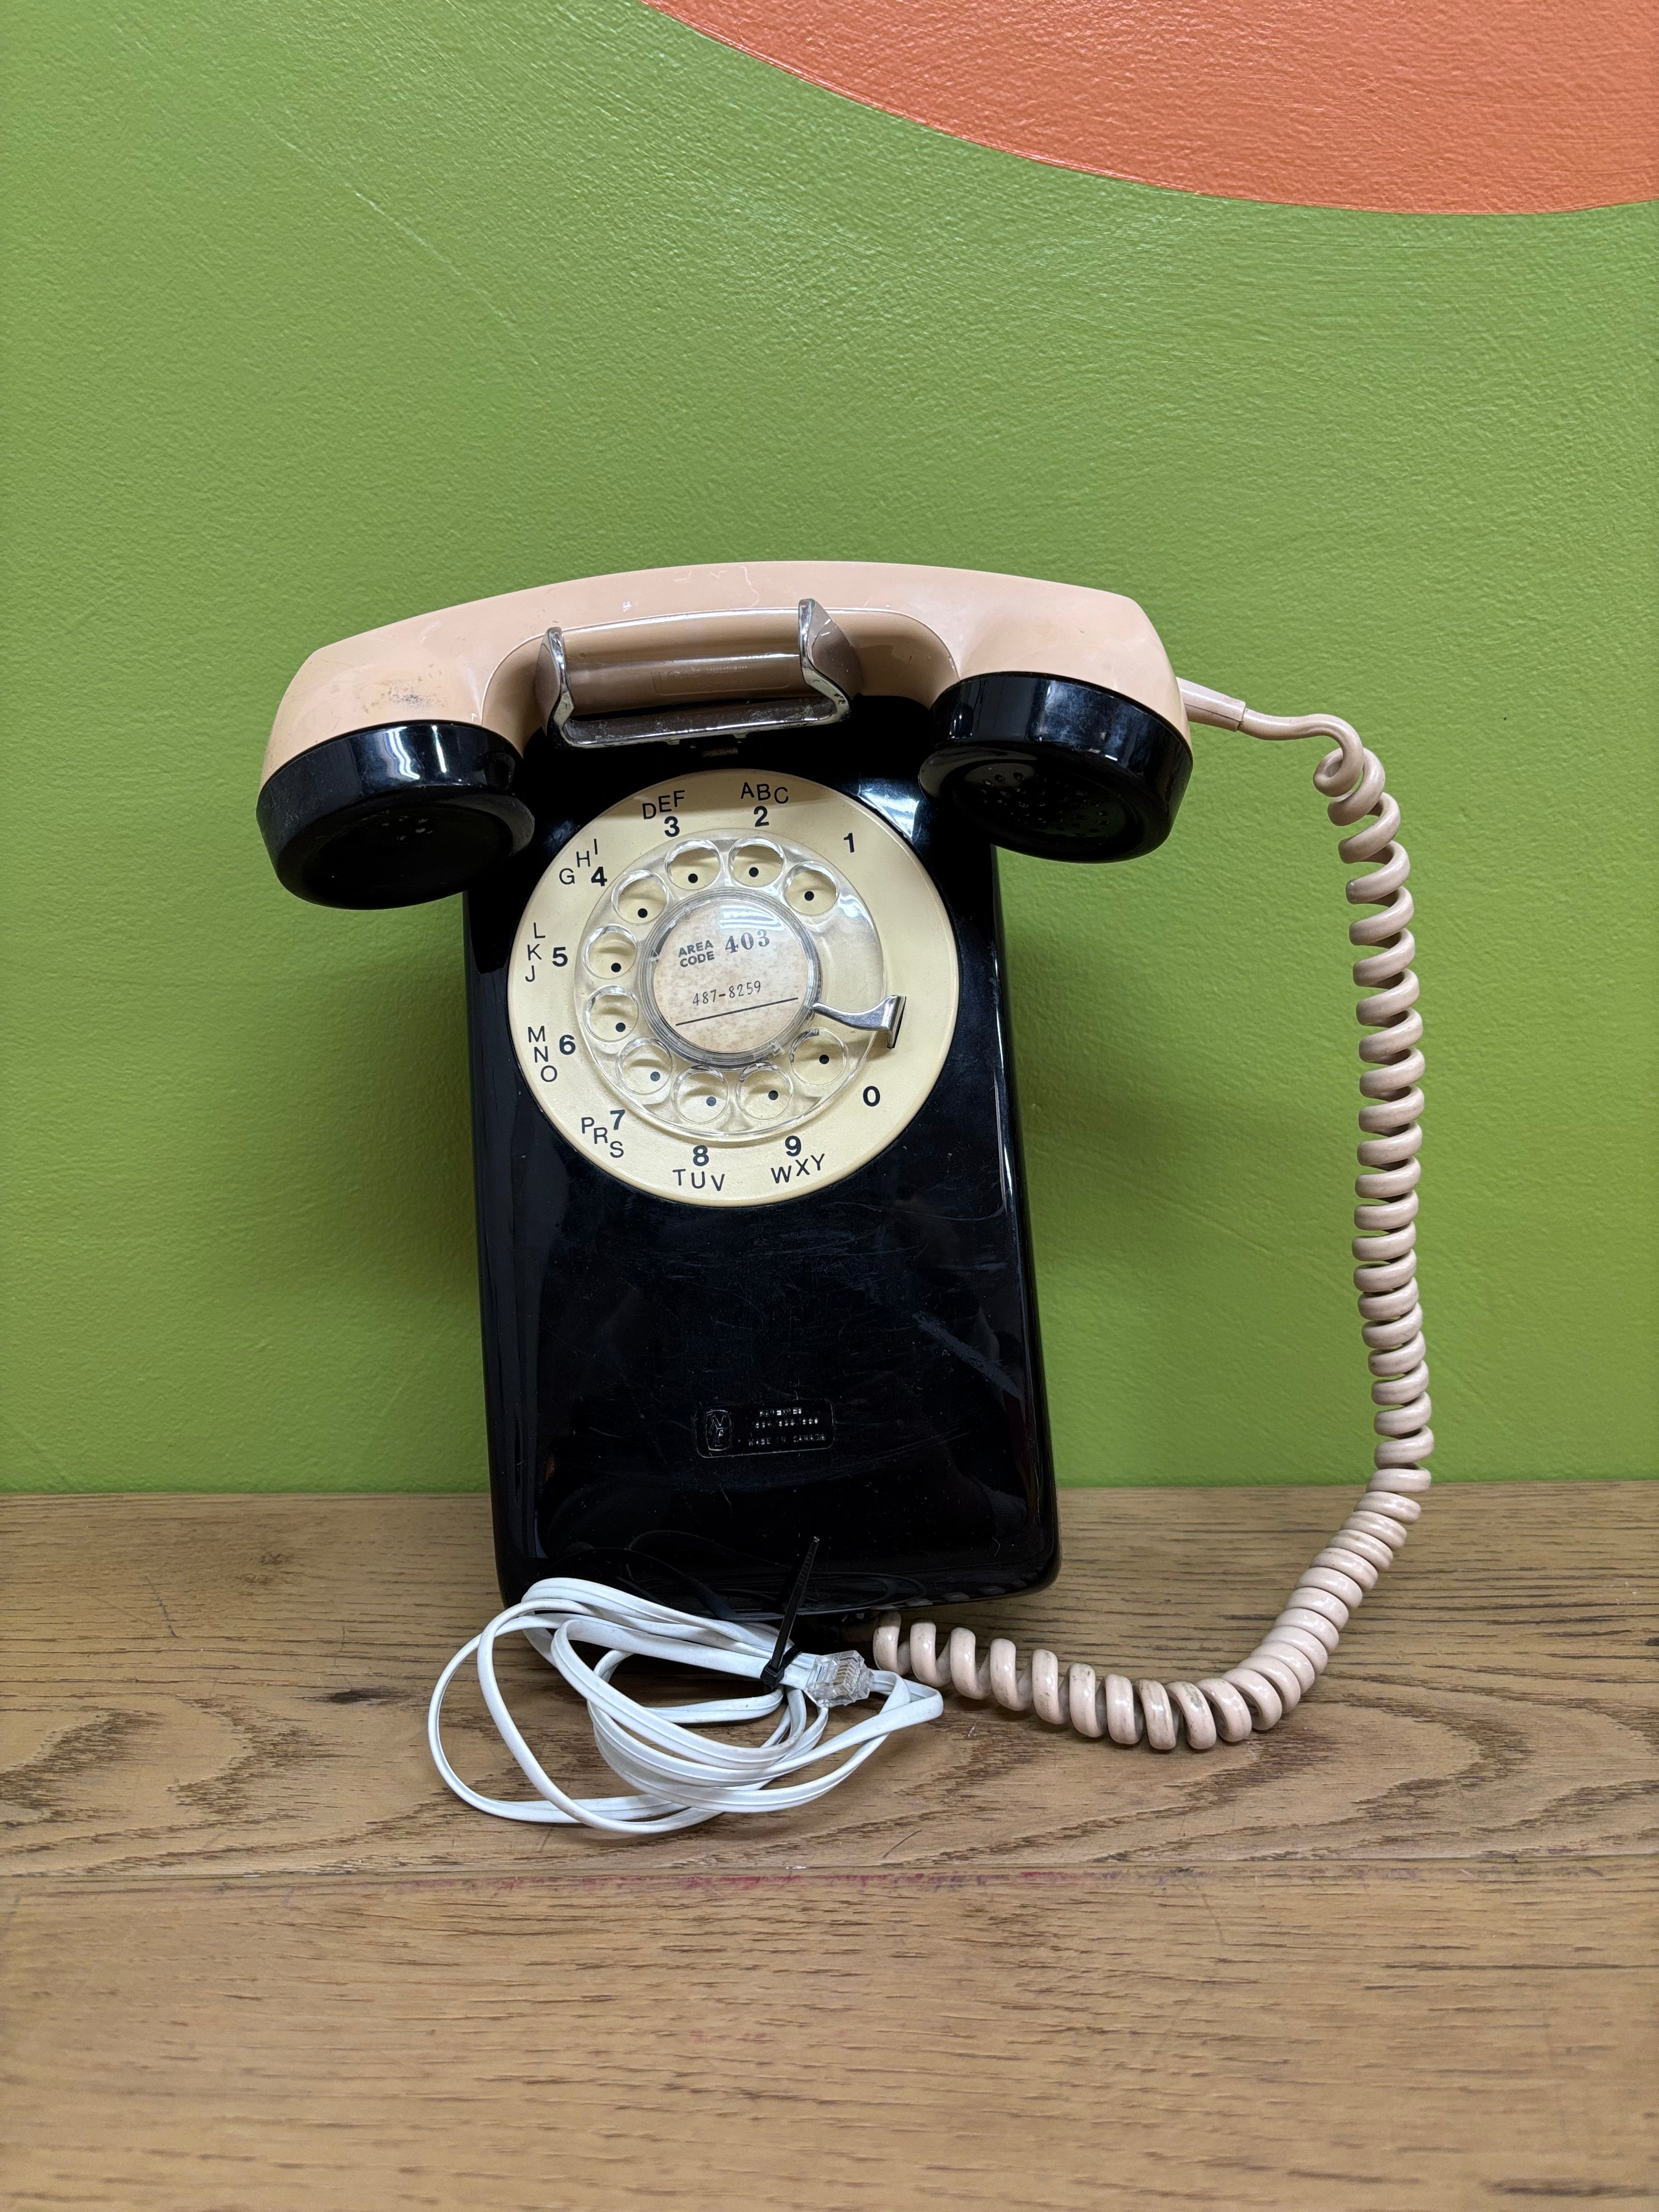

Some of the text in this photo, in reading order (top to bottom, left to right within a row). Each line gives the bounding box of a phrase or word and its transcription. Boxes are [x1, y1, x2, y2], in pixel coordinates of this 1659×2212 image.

[740, 782, 789, 804] ABC
[642, 789, 685, 820] DEF
[664, 816, 680, 838] 3
[753, 805, 770, 827] 2
[843, 832, 855, 853] 1
[591, 866, 608, 887] 4
[678, 940, 714, 958] AREA
[724, 929, 770, 953] 403
[552, 946, 568, 967] 5
[679, 951, 715, 967] CODE
[692, 980, 761, 1006] 487-8259
[559, 1034, 576, 1056] 6
[610, 1109, 625, 1131] 7
[692, 1144, 712, 1167] 8
[785, 1135, 802, 1157] 9
[770, 1153, 826, 1185] WXY
[673, 1169, 725, 1192] TUV
